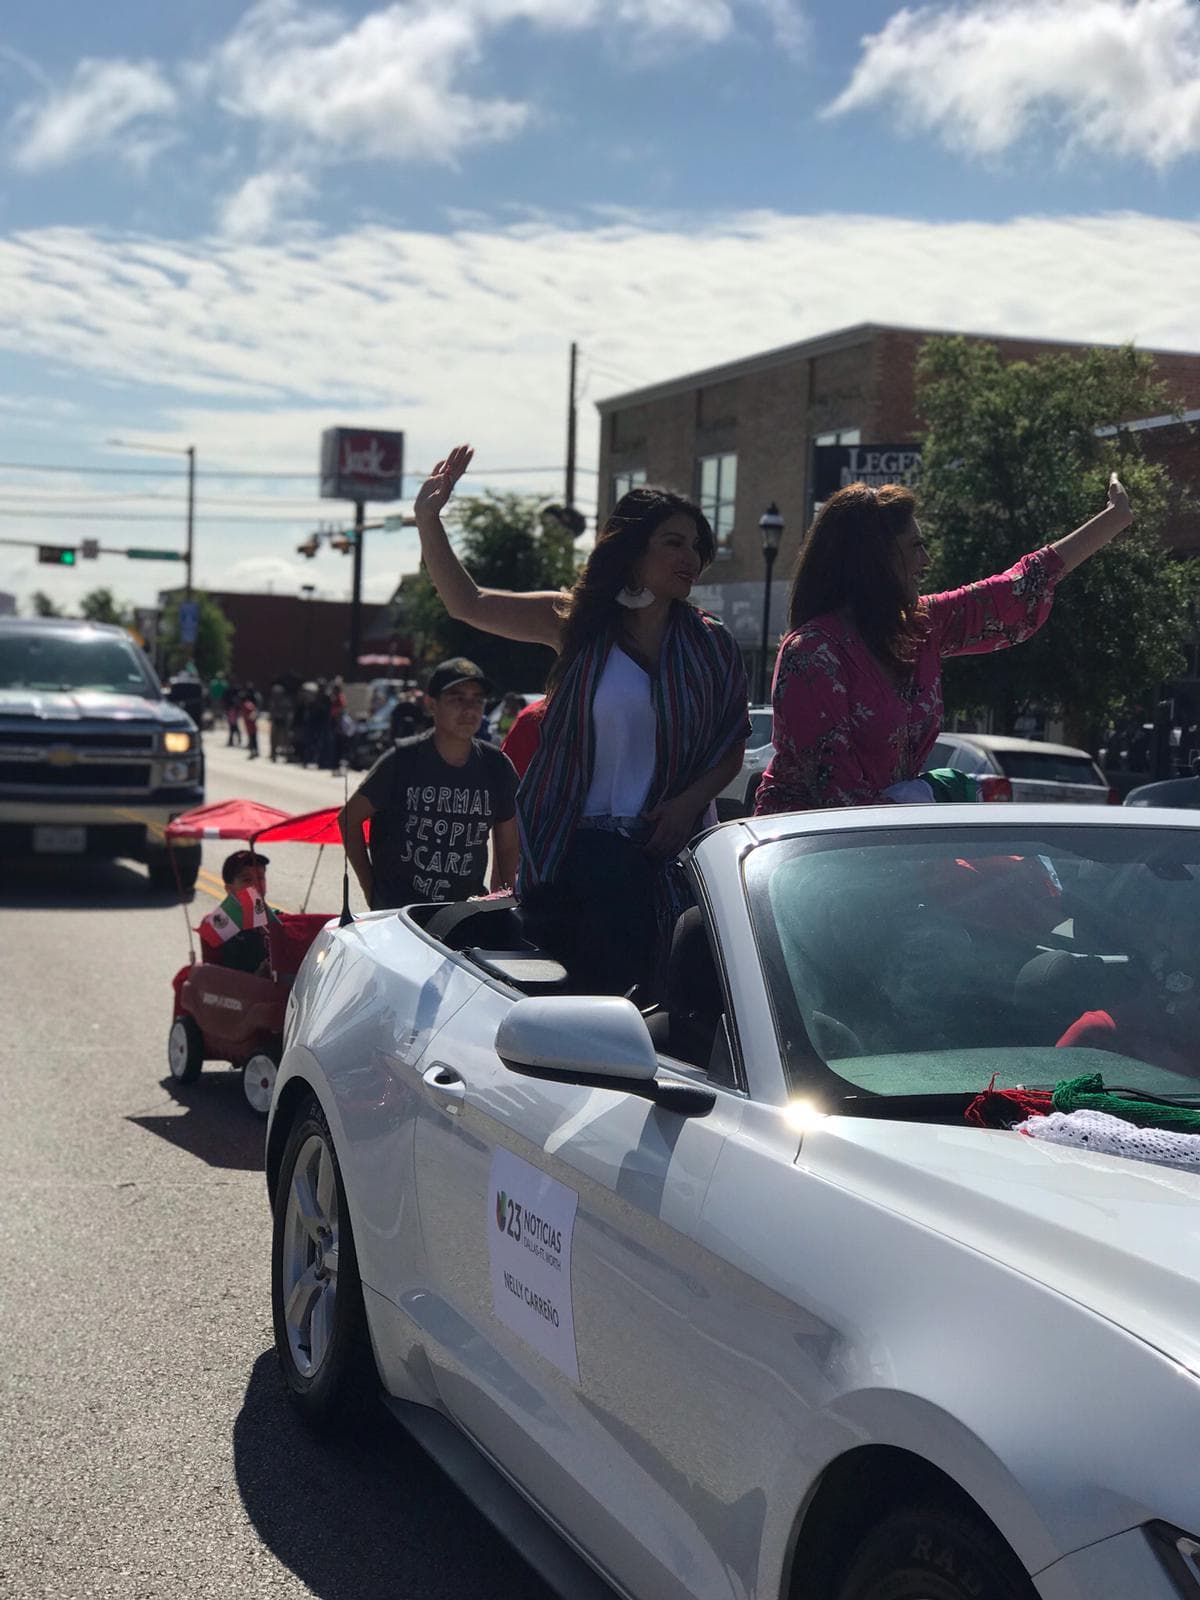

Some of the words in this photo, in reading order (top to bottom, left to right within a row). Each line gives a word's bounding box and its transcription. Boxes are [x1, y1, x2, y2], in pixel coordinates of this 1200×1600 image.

[407, 786, 492, 816] NORMAL
[405, 815, 488, 847] PEOPLE
[400, 840, 473, 876] SCARE
[507, 1199, 522, 1242] 23
[524, 1209, 562, 1254] NOTICIAS
[504, 1270, 523, 1301] NELLY
[524, 1287, 560, 1328] CARREÑO
